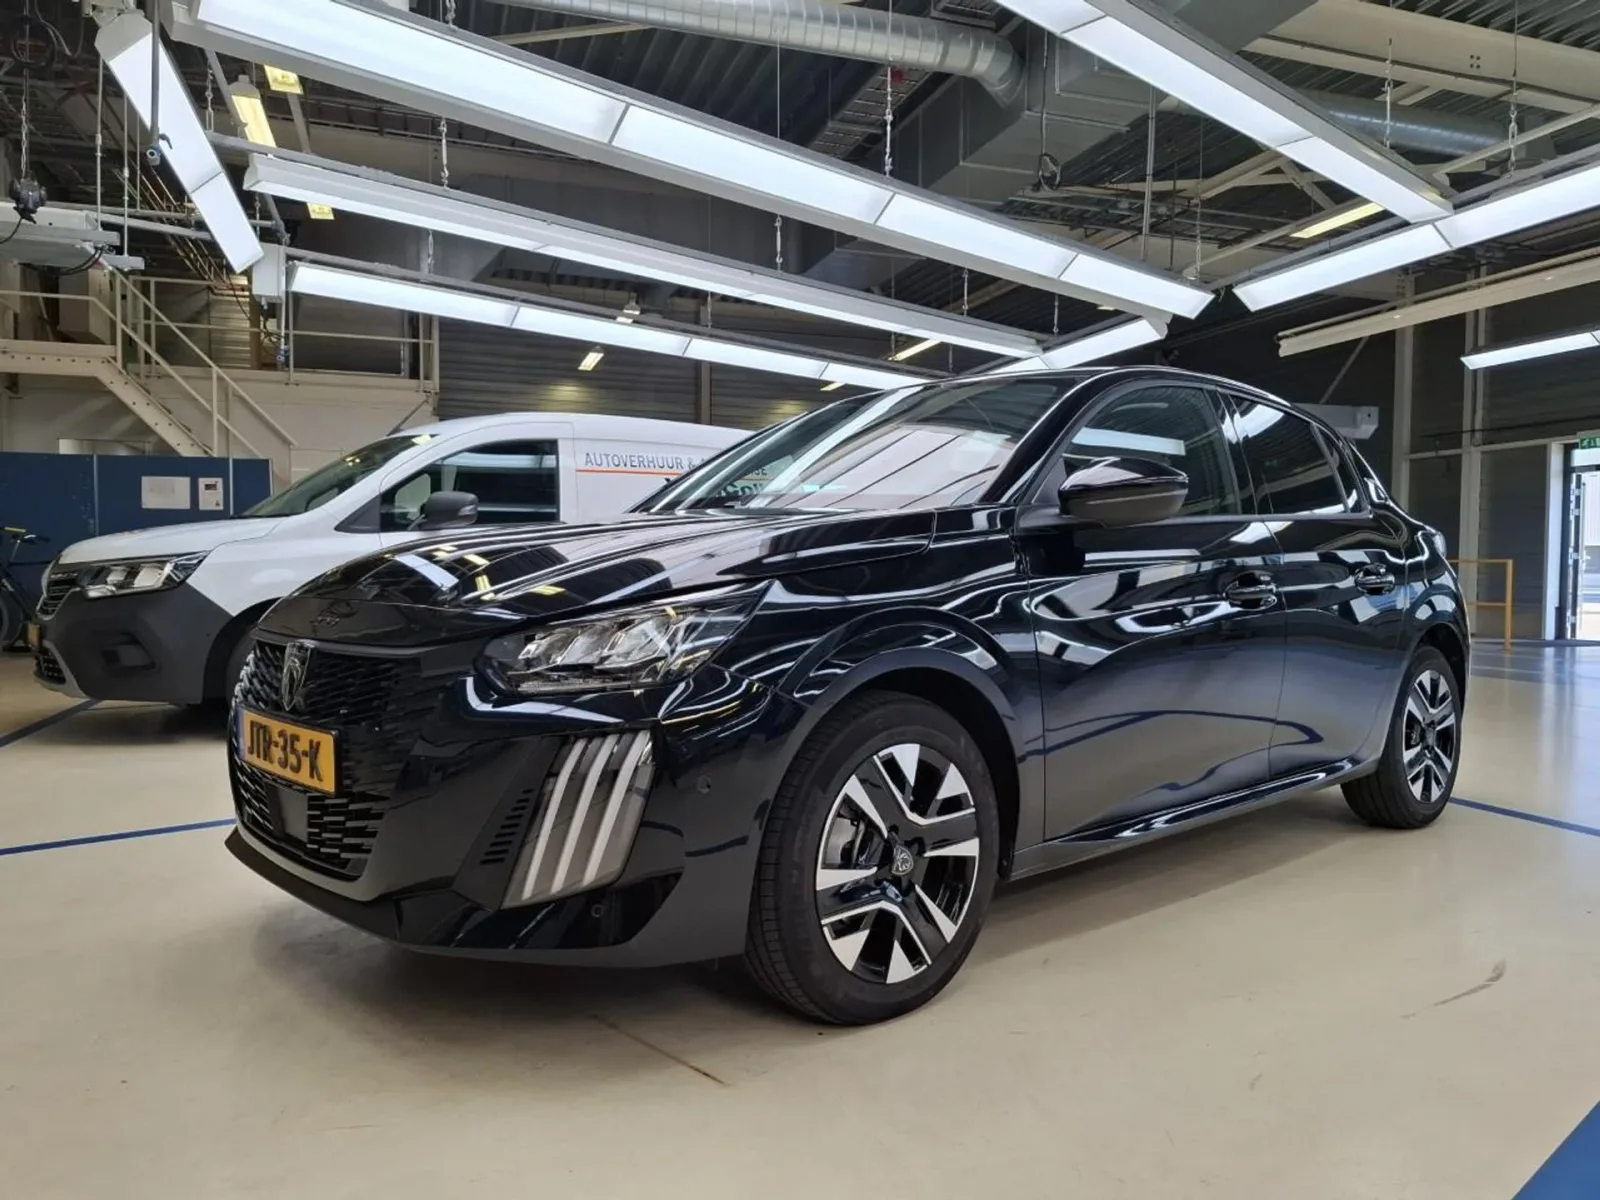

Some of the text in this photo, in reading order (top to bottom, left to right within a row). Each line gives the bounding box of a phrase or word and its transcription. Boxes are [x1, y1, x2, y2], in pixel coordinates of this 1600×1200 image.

[585, 452, 684, 470] AUTOVERHUUR
[687, 456, 697, 470] &
[247, 719, 324, 783] JTR-35-K
